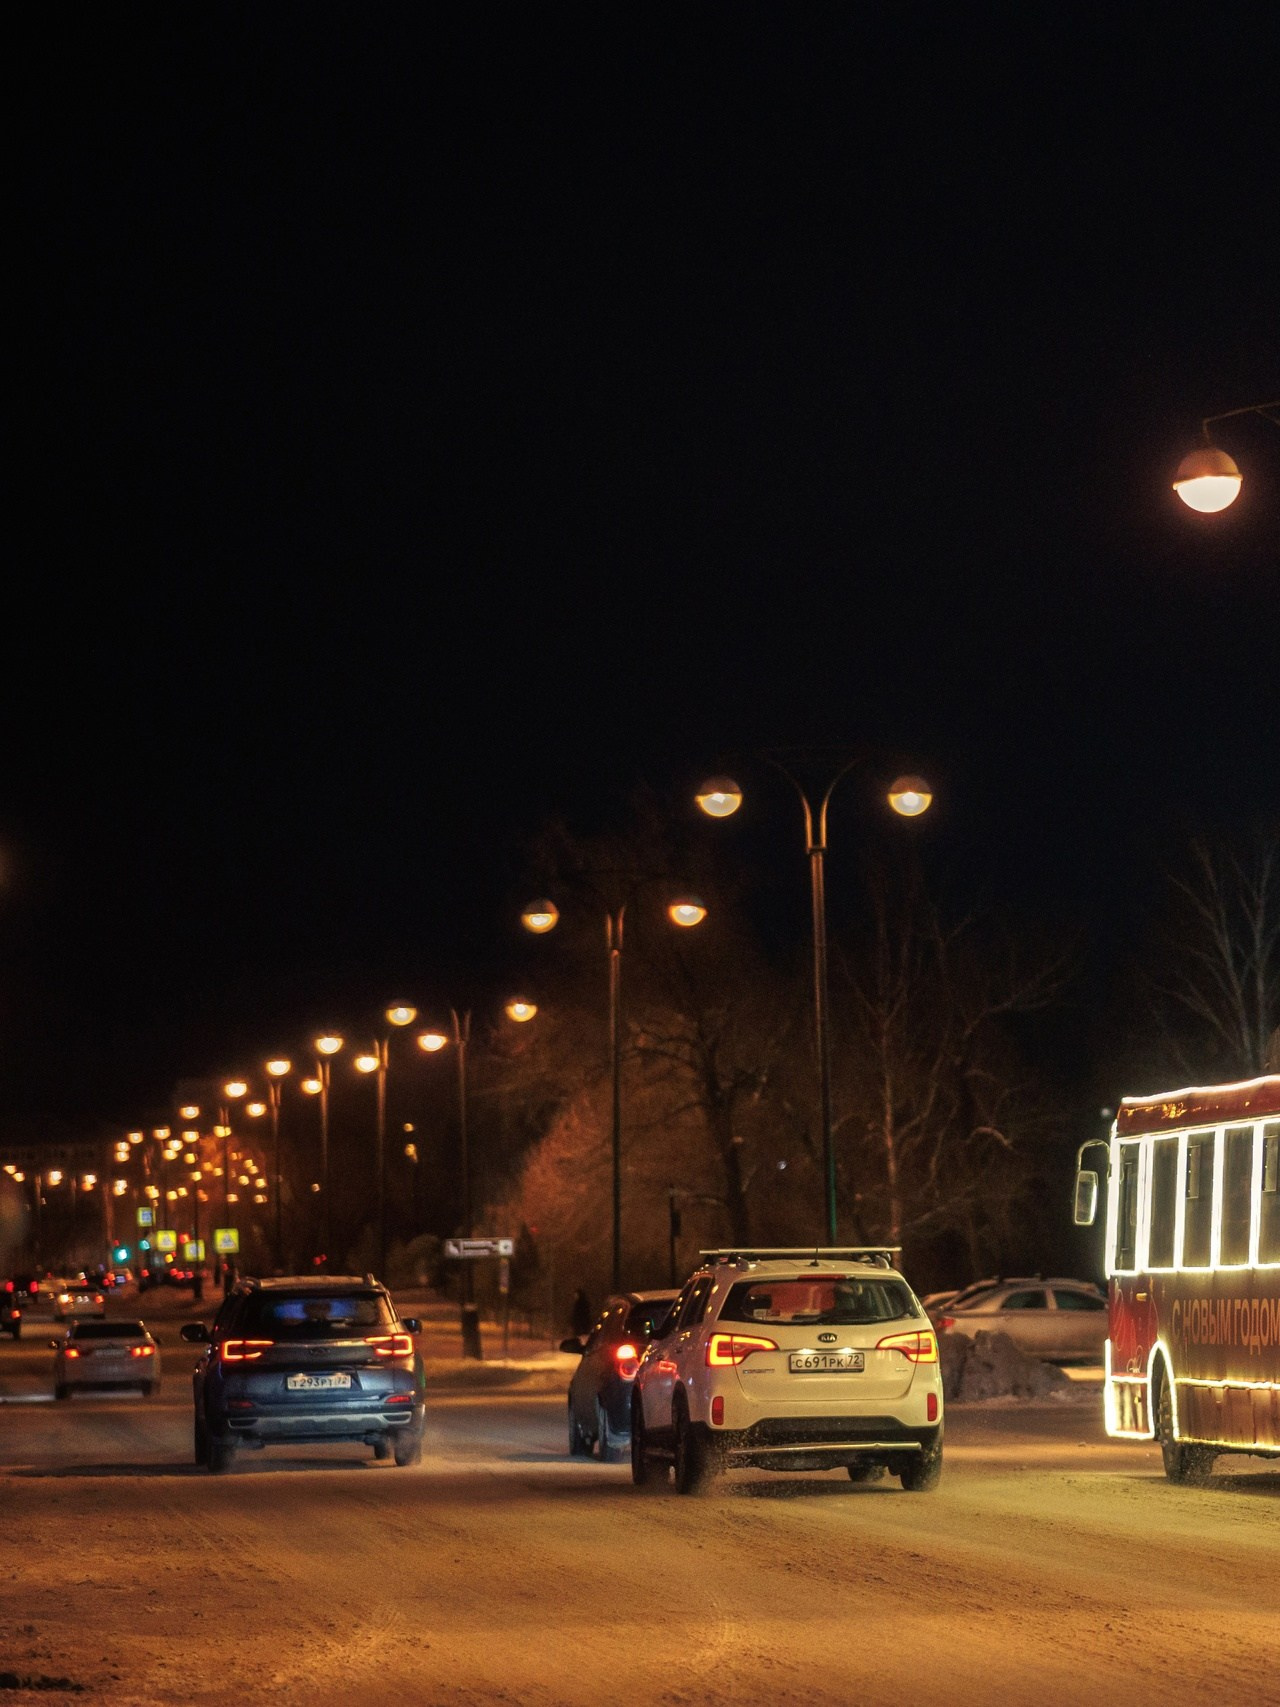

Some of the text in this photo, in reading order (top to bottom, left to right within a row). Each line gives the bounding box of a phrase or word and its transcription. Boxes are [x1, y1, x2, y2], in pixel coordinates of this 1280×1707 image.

[1172, 1299, 1181, 1343] С
[1183, 1299, 1231, 1345] НОВЫМ
[848, 1355, 860, 1365] 72
